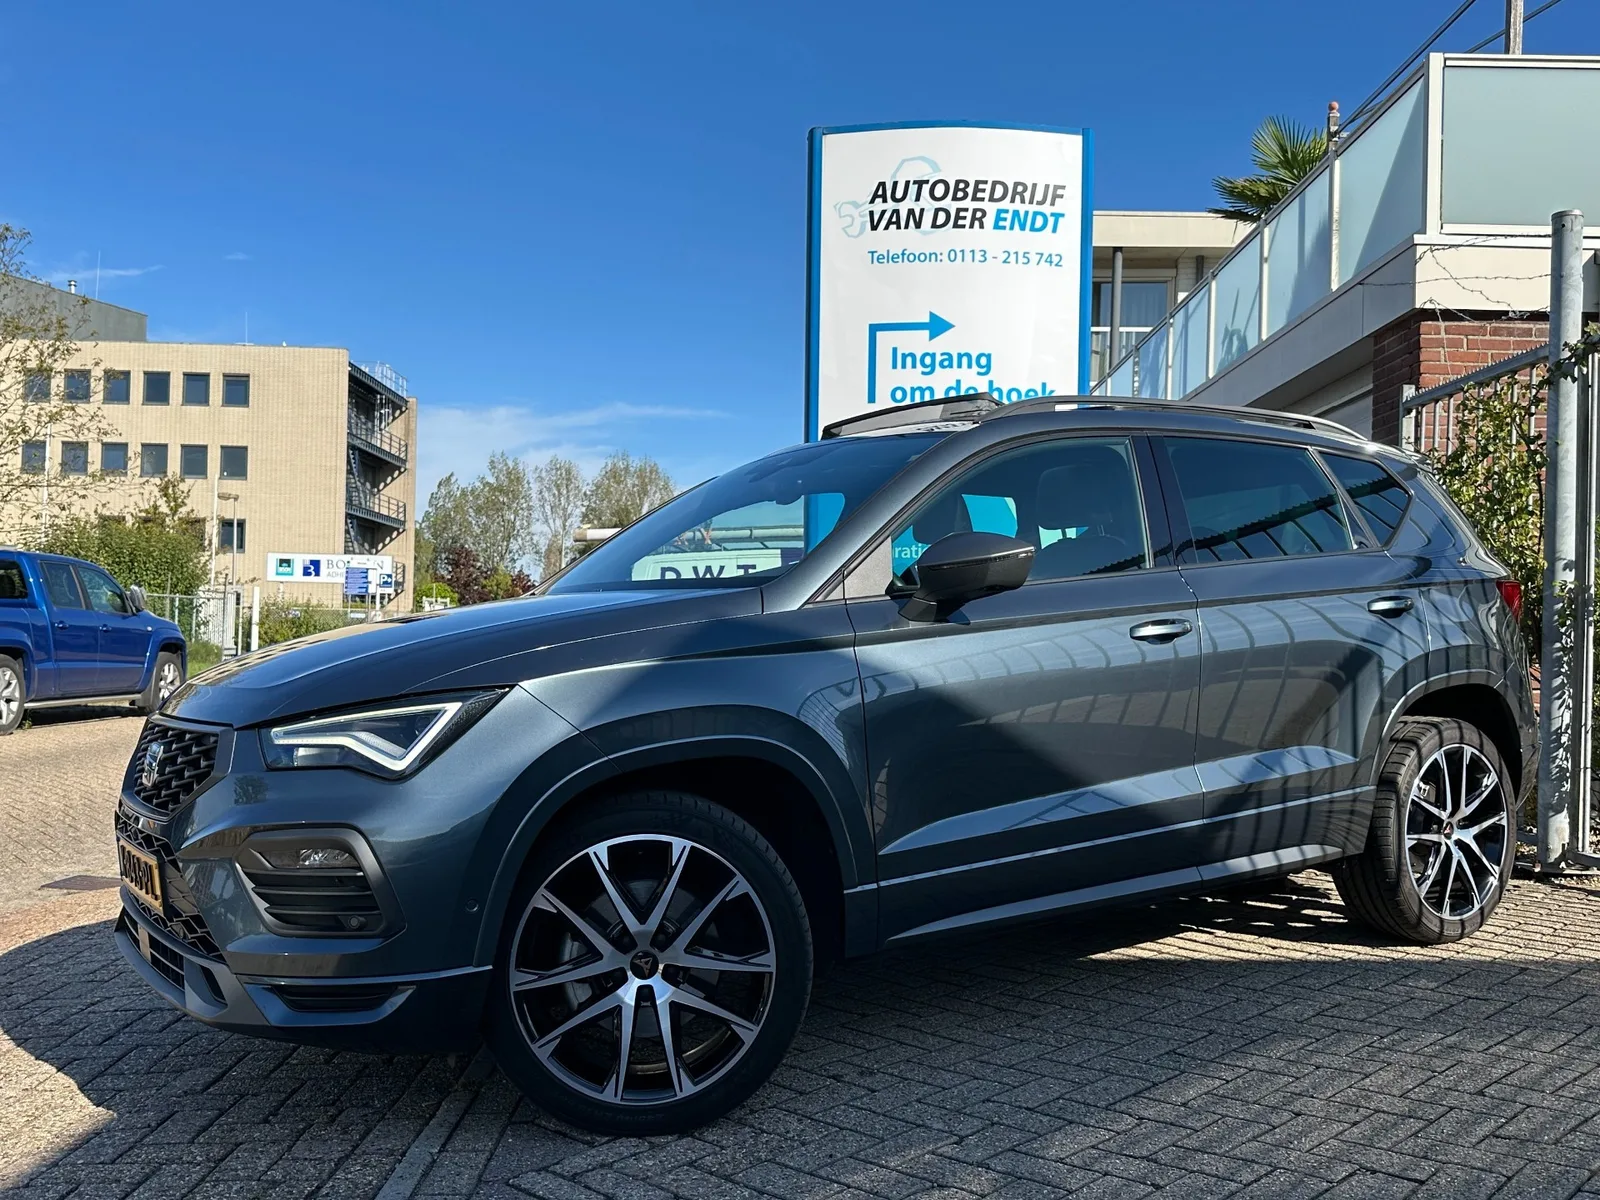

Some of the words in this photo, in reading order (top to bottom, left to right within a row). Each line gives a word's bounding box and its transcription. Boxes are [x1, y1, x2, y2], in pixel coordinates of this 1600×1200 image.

[868, 178, 1066, 207] AUTOBEDRIJF
[868, 207, 925, 231] VAN
[930, 207, 987, 230] DER
[992, 208, 1066, 234] ENDT
[867, 248, 944, 265] Telefoon:
[947, 248, 988, 263] 0113
[1001, 250, 1031, 266] 215
[1034, 252, 1063, 268] 742
[891, 346, 992, 376] Ingang
[890, 385, 935, 403] om
